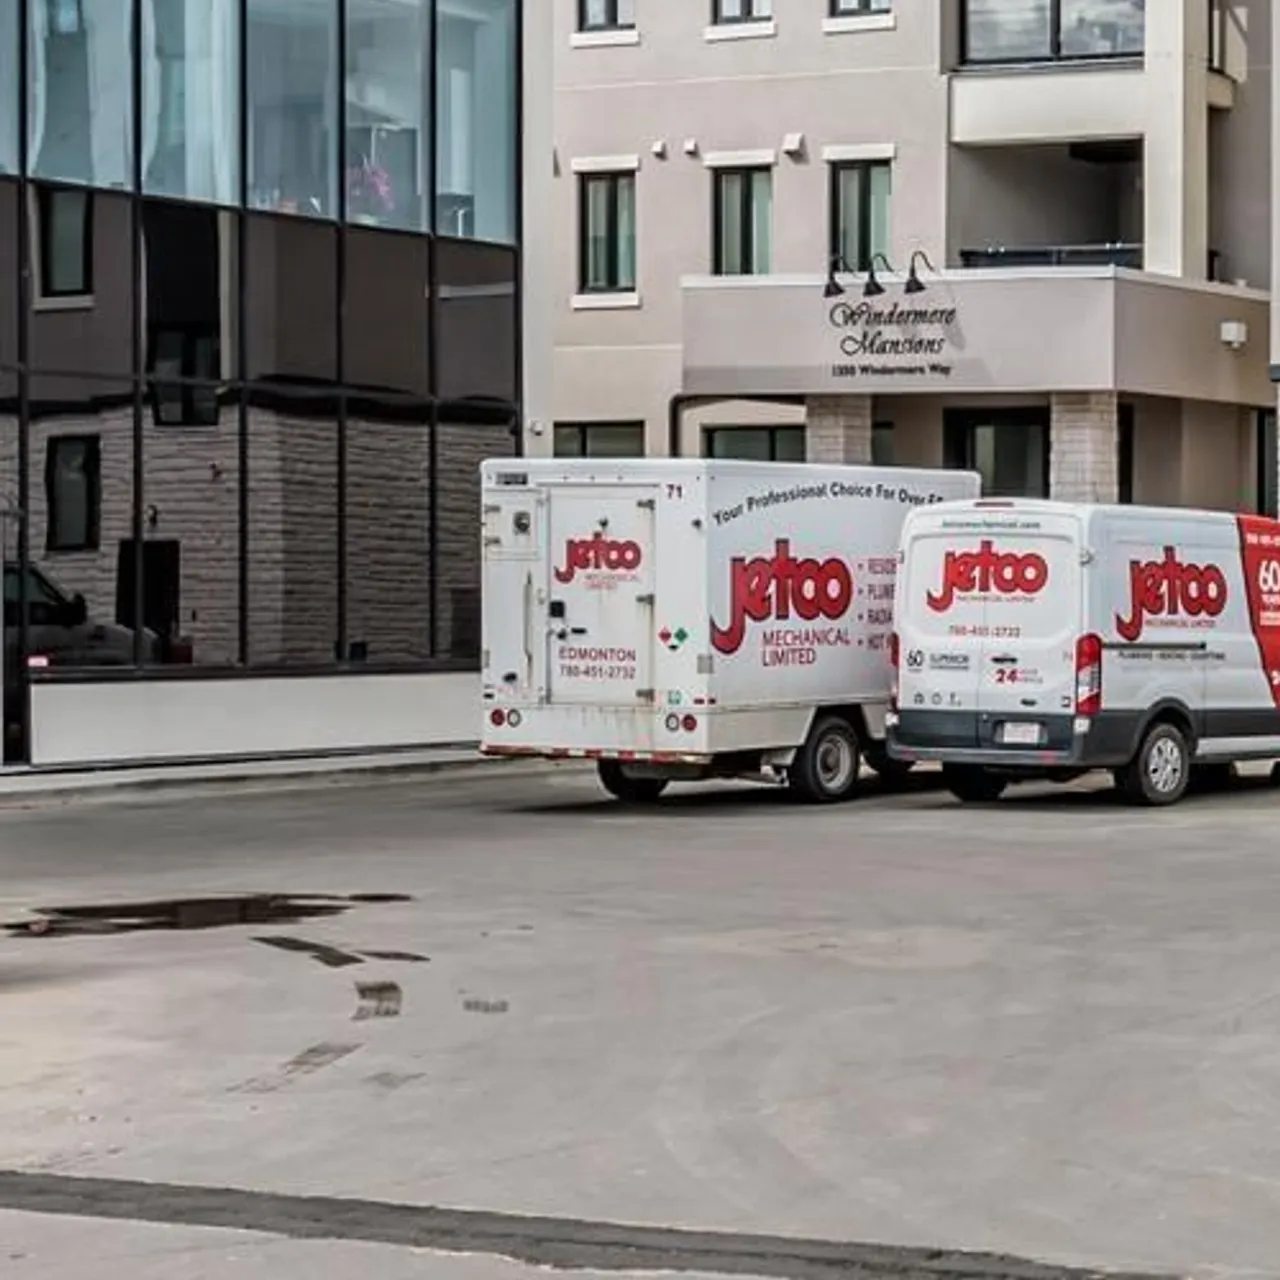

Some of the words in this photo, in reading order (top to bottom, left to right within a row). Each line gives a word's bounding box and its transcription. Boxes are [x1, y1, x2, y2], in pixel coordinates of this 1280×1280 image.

[829, 302, 957, 328] Windermere
[840, 330, 945, 356] Mansions
[666, 484, 682, 499] 71
[713, 504, 744, 524] Your
[747, 484, 828, 513] Professional
[829, 481, 872, 499] Choice
[875, 483, 895, 500] For
[898, 490, 926, 506] Over
[762, 626, 852, 648] MECHANICAL
[559, 646, 637, 662] EDMONTON
[762, 647, 817, 667] LIMITED
[995, 668, 1018, 684] 24
